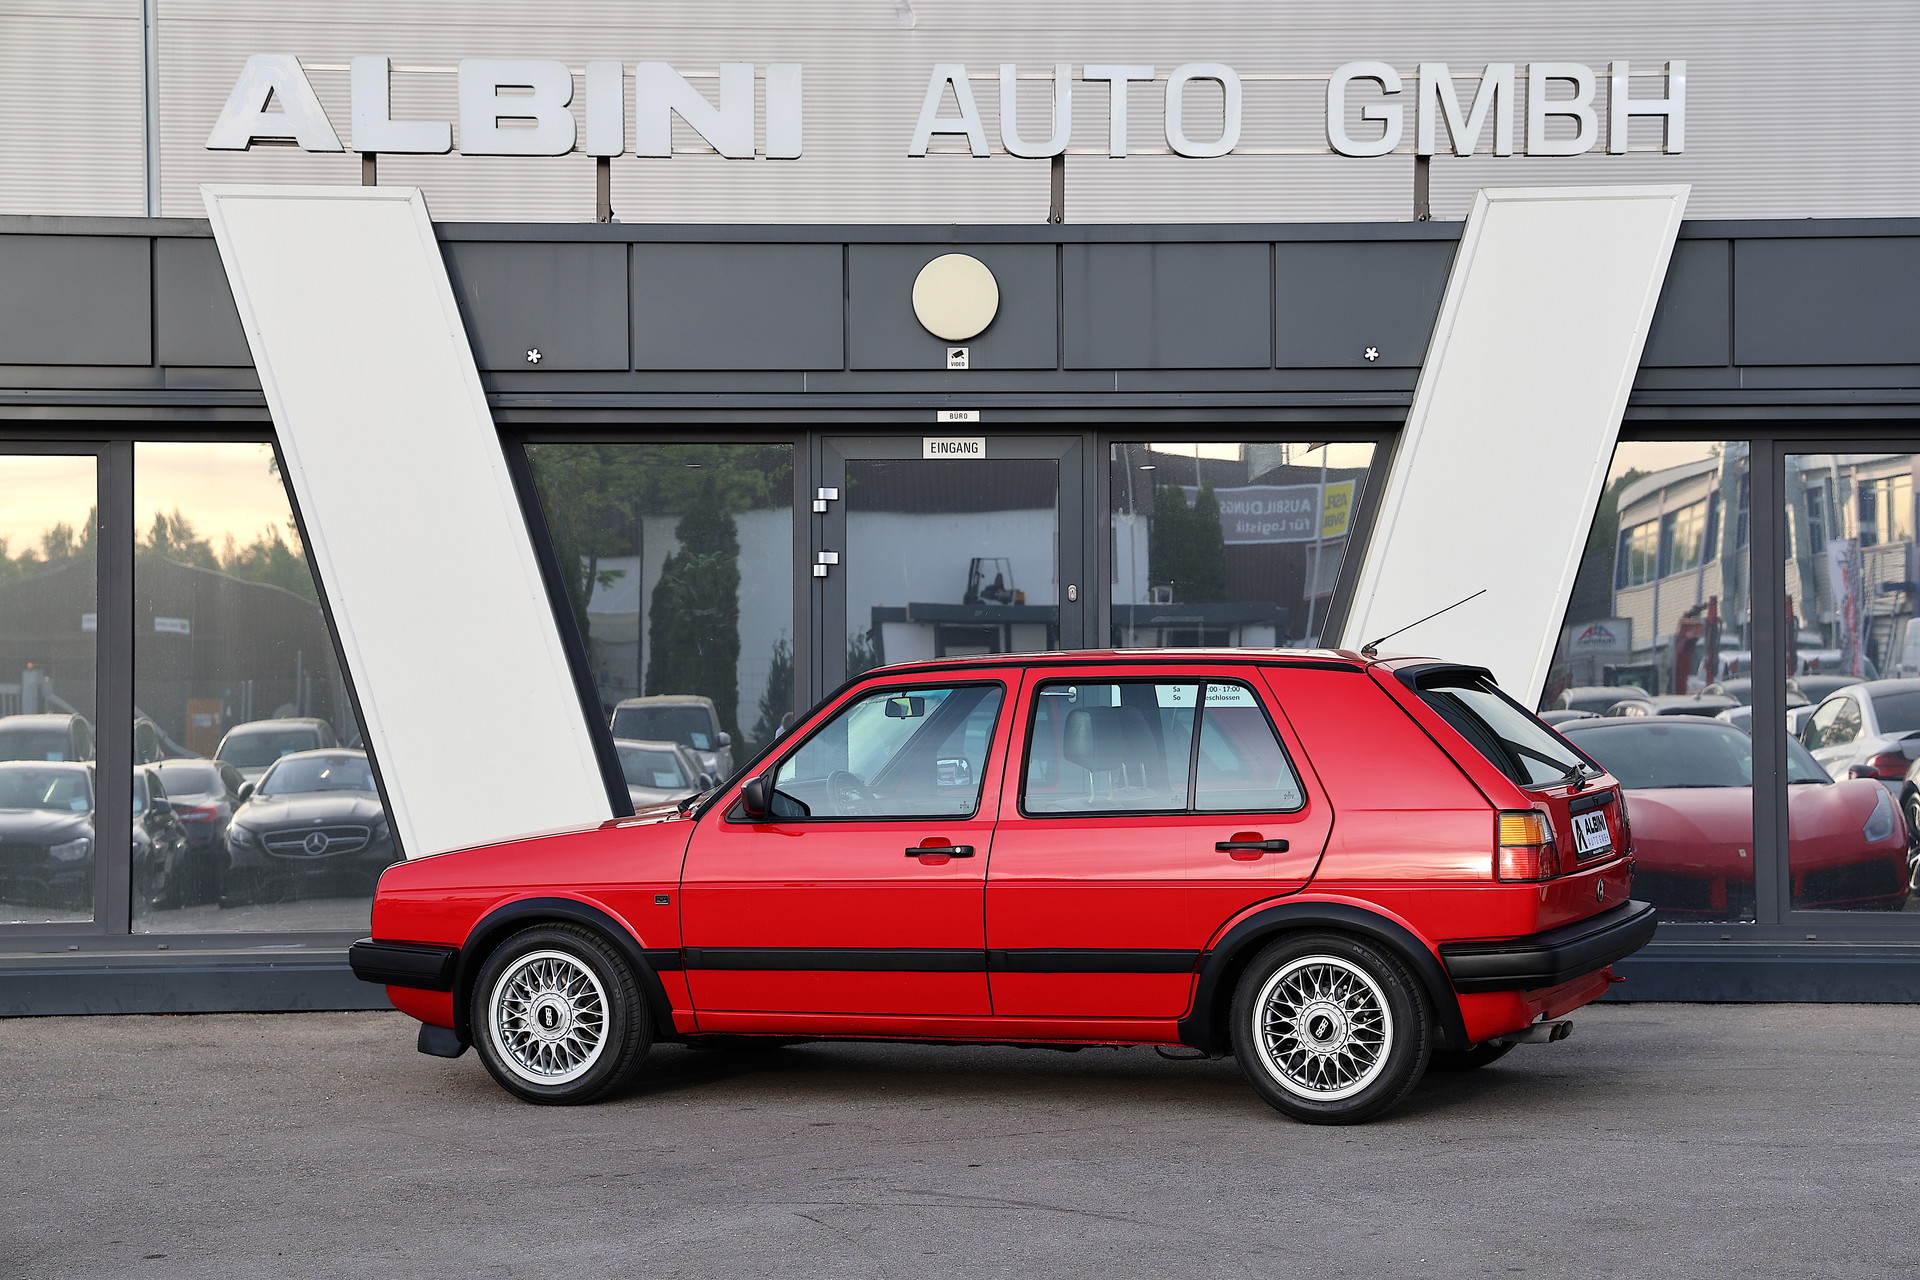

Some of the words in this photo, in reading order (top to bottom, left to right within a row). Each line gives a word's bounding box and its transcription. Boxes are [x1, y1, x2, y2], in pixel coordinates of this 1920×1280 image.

[205, 53, 803, 160] ALBINI
[908, 62, 1242, 159] AUTO
[1326, 60, 1687, 158] GMBH
[949, 411, 968, 420] BÜRO
[930, 442, 979, 454] EINGANG
[1352, 945, 1398, 987] NEXEN
[545, 1007, 553, 1026] BBS
[1315, 1017, 1329, 1038] BBS
